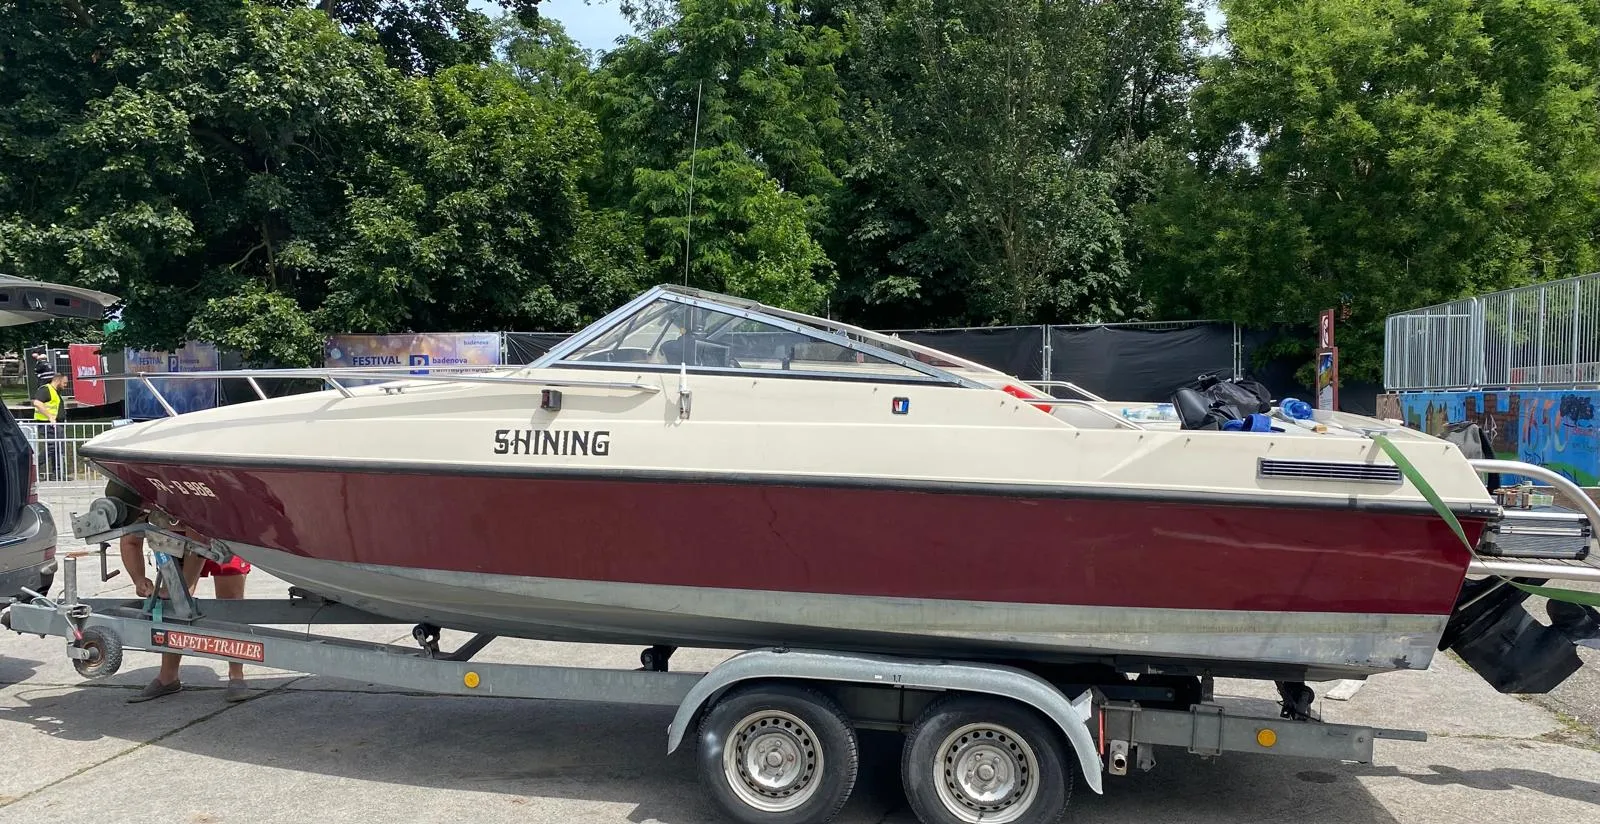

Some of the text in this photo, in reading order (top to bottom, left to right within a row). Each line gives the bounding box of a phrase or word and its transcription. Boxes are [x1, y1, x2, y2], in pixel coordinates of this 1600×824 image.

[353, 355, 402, 366] FESTIVAL
[494, 429, 610, 456] SHINING
[183, 481, 216, 497] 986
[169, 633, 261, 658] SAFETY-TRAILER
